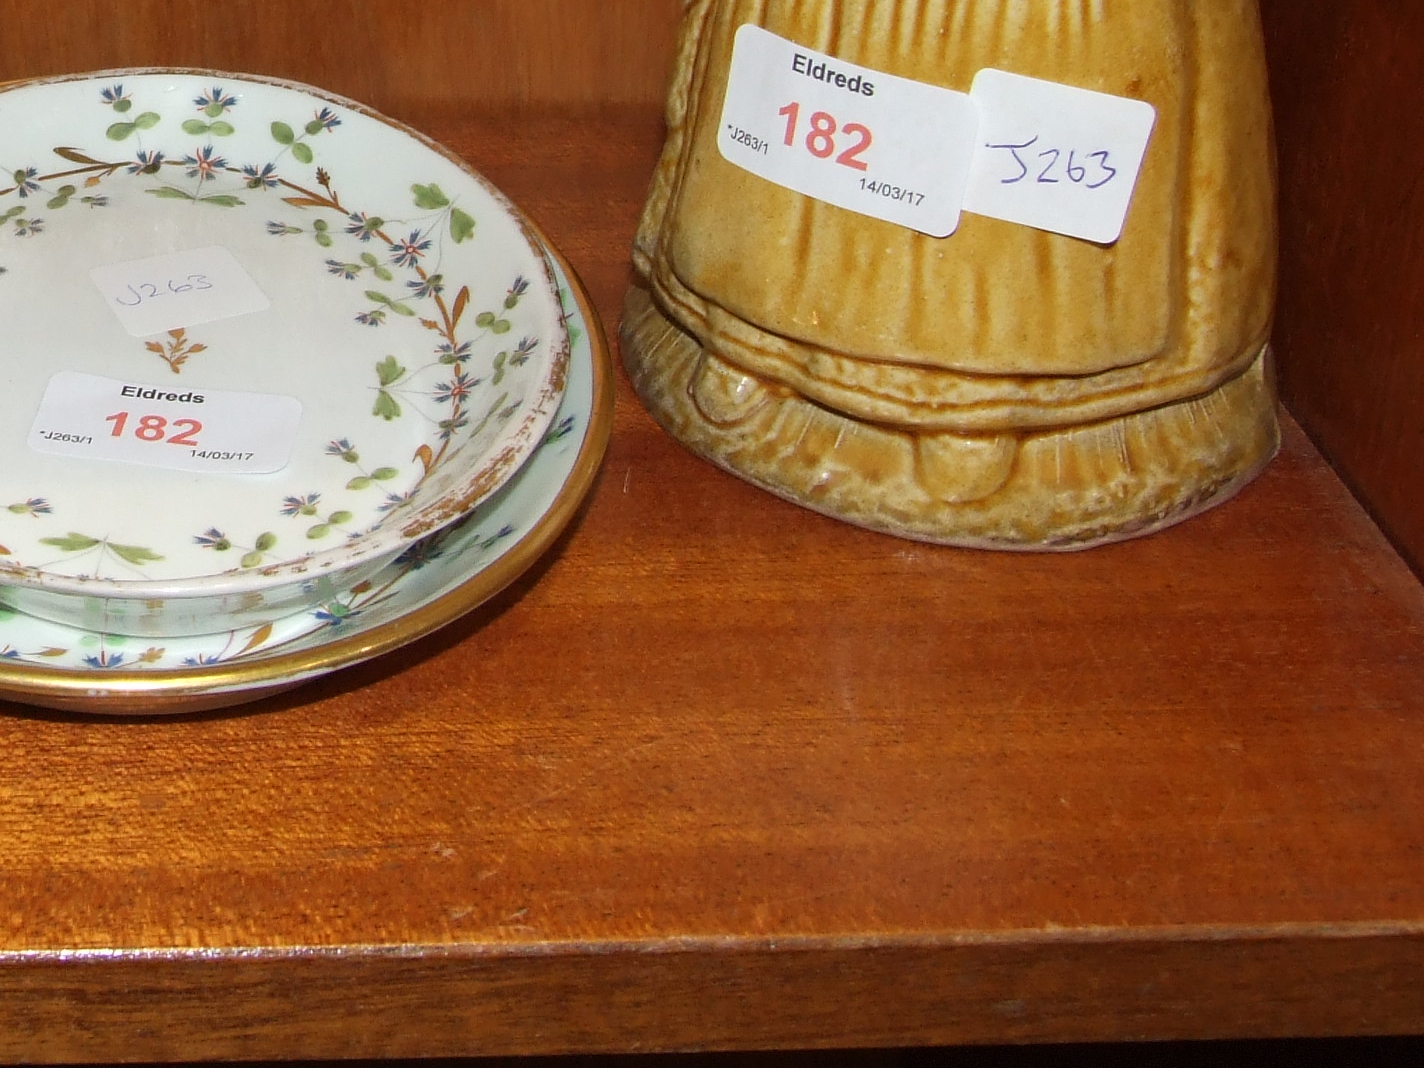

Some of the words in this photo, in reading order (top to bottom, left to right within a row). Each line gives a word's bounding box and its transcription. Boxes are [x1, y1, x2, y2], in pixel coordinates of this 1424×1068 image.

[791, 53, 876, 98] Eldreds
[778, 101, 873, 171] 182
[985, 135, 1117, 189] J263
[859, 177, 925, 207] 14/03/17
[116, 274, 213, 306] J263
[120, 385, 205, 404] Eldreds
[105, 411, 203, 446] 182
[190, 449, 254, 461] 14/03/17
